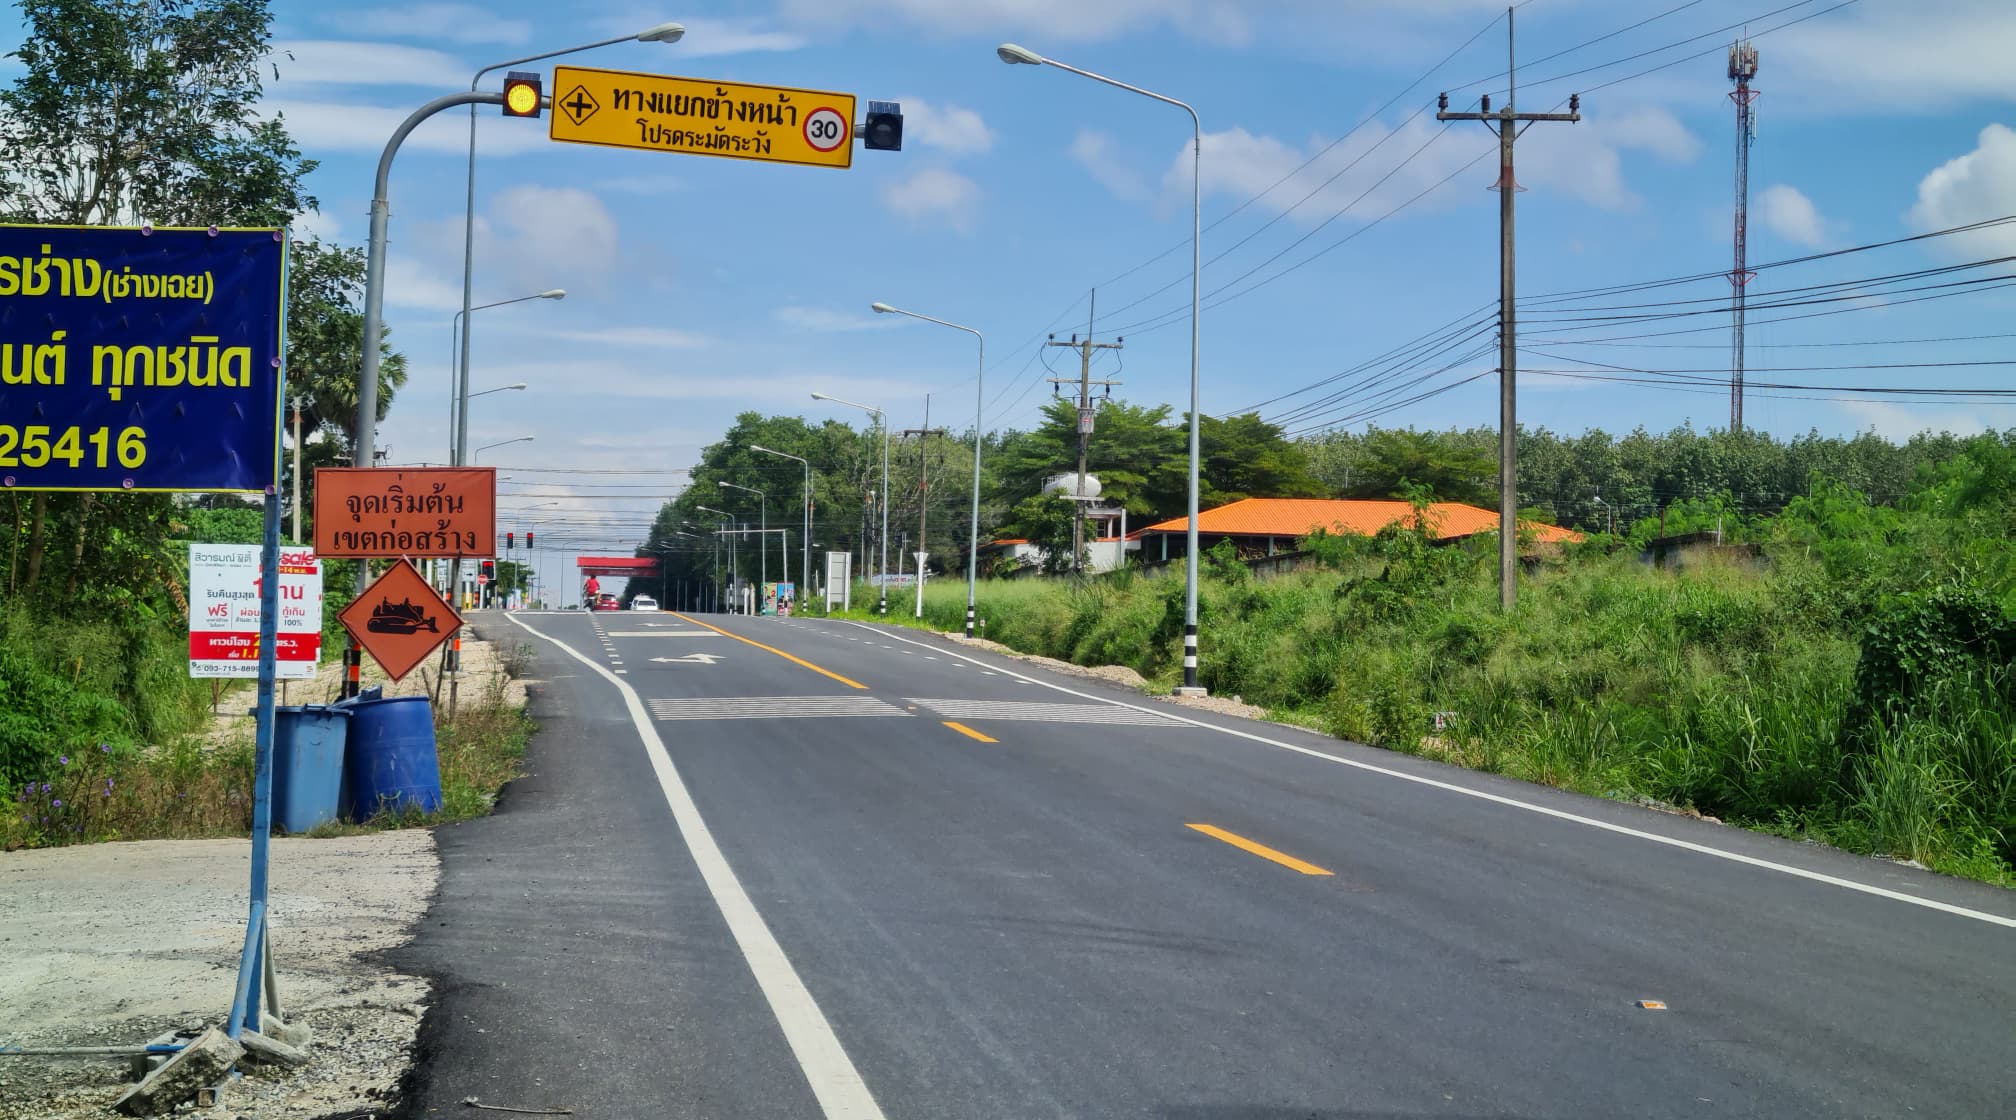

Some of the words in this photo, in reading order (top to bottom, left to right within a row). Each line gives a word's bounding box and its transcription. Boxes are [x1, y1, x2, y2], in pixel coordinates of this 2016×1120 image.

[612, 86, 798, 127] ทางแยกข้างหน้า
[635, 118, 772, 155] โปรดระมัดระวัง
[810, 119, 839, 140] 30
[91, 335, 252, 401] ทุกชนิด
[0, 425, 148, 469] 25416
[345, 473, 464, 523] จุดเริ่มต้น
[332, 518, 477, 551] เขตก่อสร้าง
[280, 551, 315, 566] sale
[207, 602, 228, 617] ฟรี
